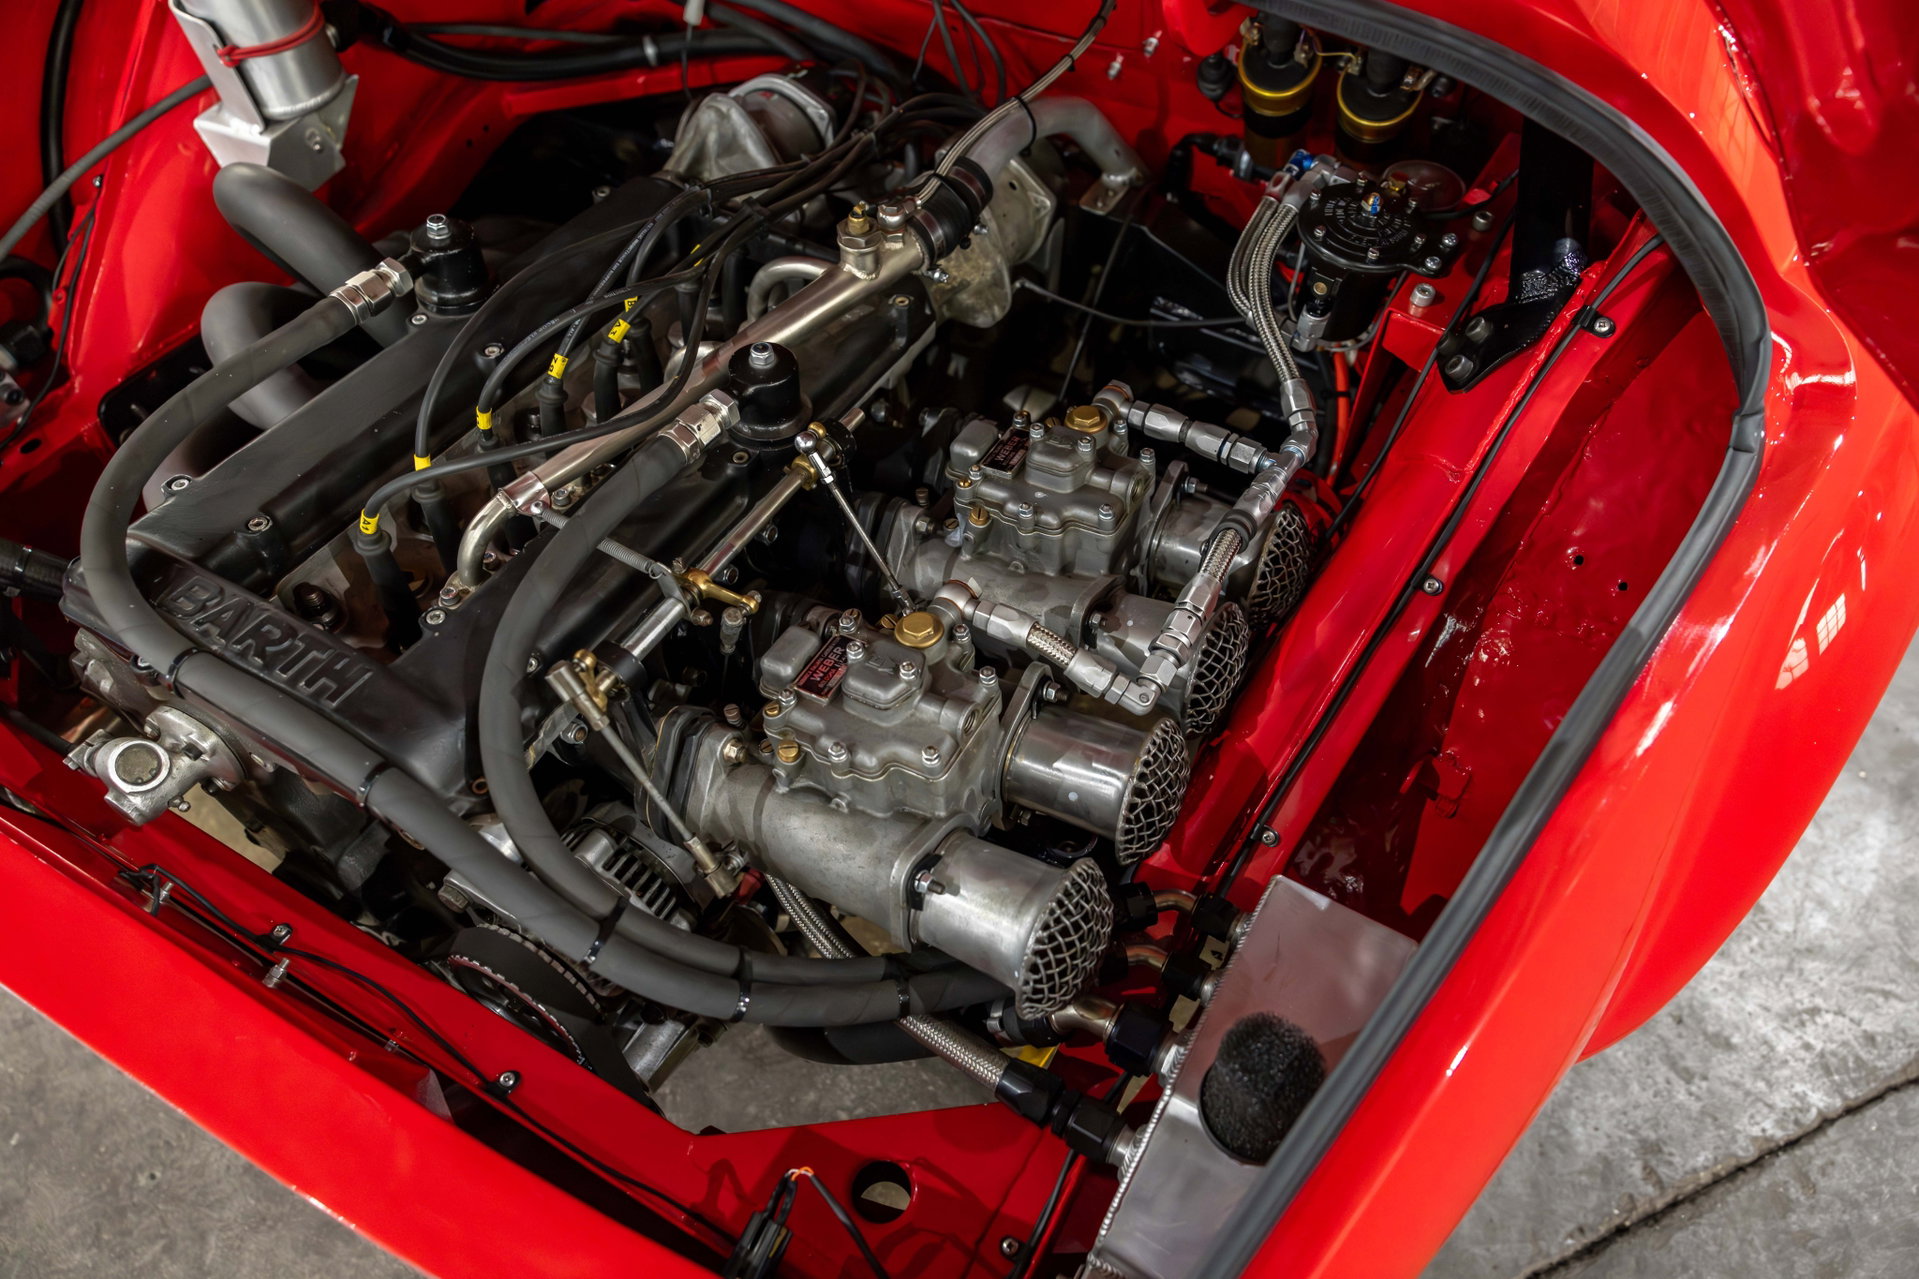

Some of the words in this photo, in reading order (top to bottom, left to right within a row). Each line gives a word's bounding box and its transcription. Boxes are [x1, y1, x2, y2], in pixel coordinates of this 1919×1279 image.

[995, 435, 1022, 462] WEBER
[361, 517, 372, 531] A1
[162, 576, 374, 706] BARTH
[810, 646, 846, 682] WEBER
